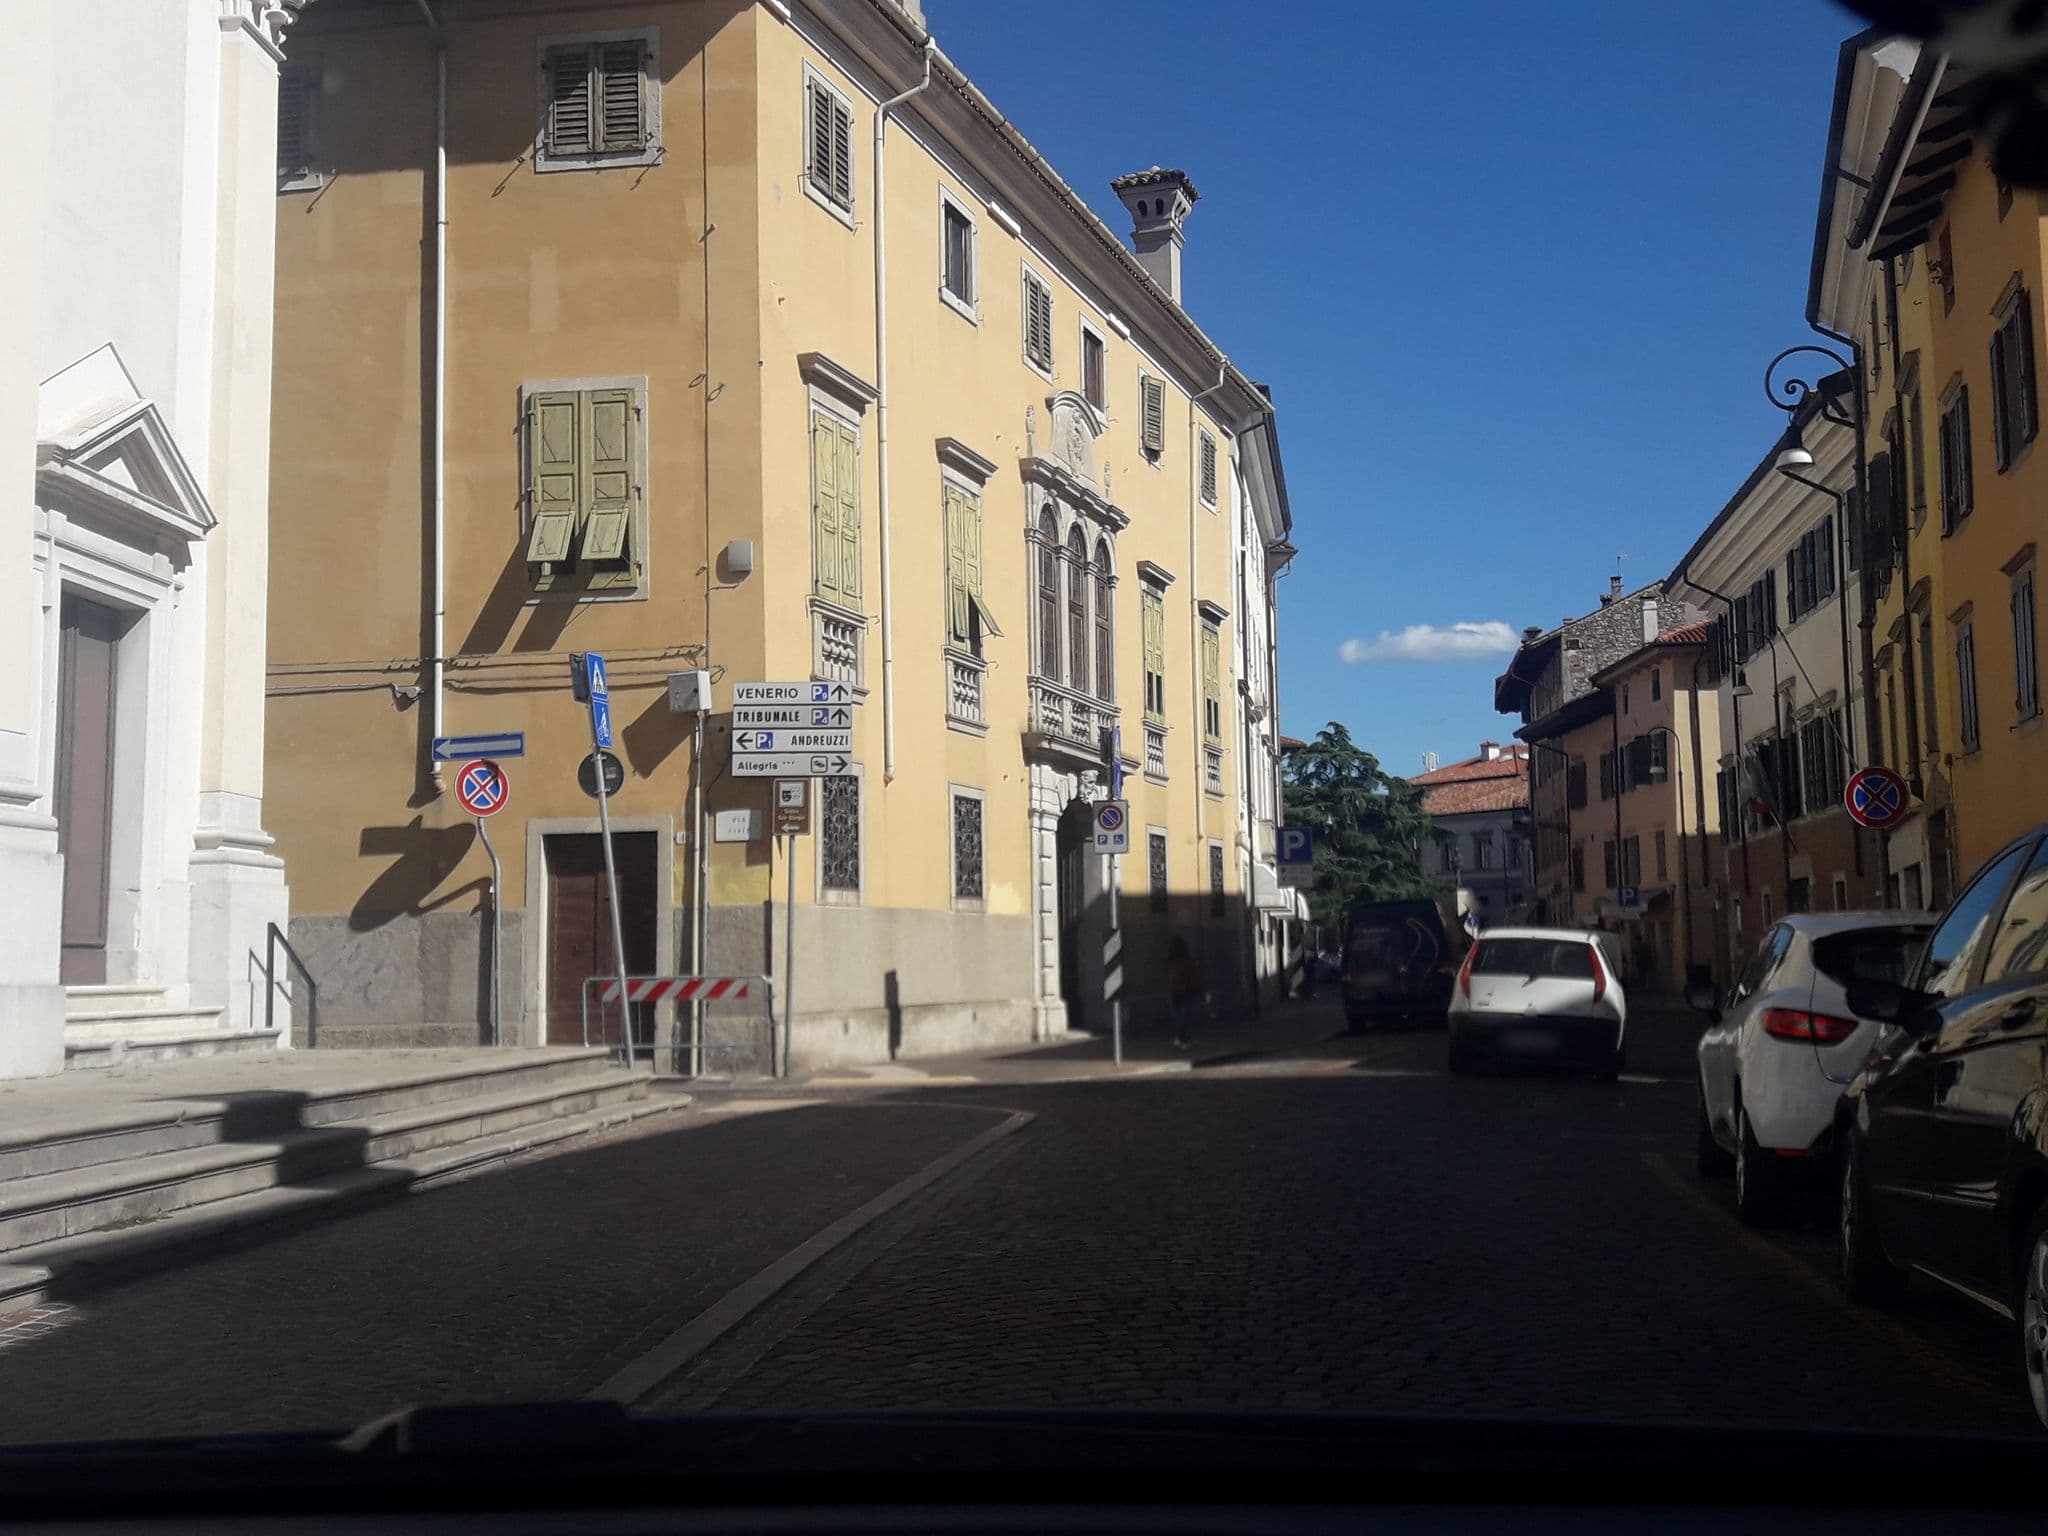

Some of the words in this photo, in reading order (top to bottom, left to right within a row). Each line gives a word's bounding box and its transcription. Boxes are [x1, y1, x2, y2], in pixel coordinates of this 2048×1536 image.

[736, 688, 798, 698] VENERIO
[737, 712, 800, 722] TRIBUNALE
[791, 736, 849, 746] ANDREUZZI
[737, 761, 778, 772] Allegria
[1283, 831, 1304, 860] P
[1622, 888, 1634, 905] P
